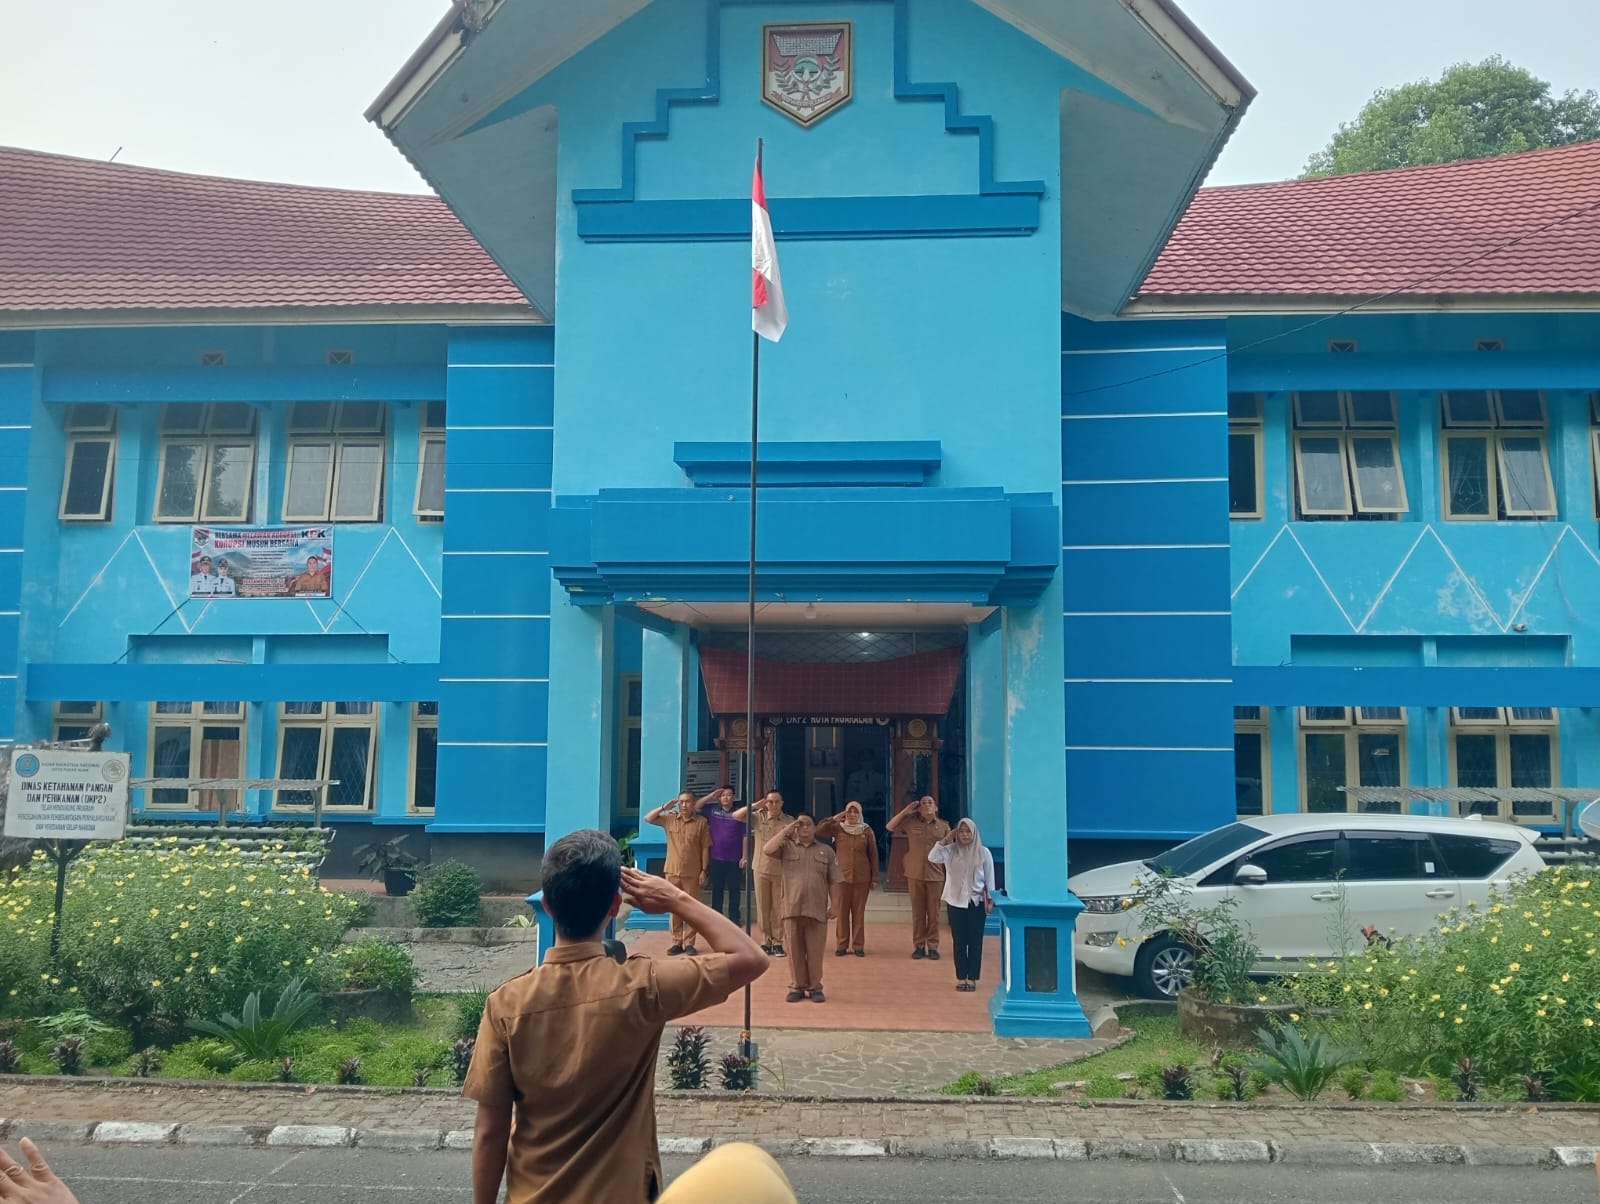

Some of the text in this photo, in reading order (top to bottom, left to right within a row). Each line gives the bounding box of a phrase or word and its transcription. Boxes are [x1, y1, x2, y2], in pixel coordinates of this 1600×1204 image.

[301, 529, 326, 538] KPK
[246, 539, 268, 548] MUSUH
[21, 782, 113, 793] DINAS KETAHANAN PANGAN
[26, 794, 41, 803] DAN
[42, 794, 80, 804] PERIKANAN
